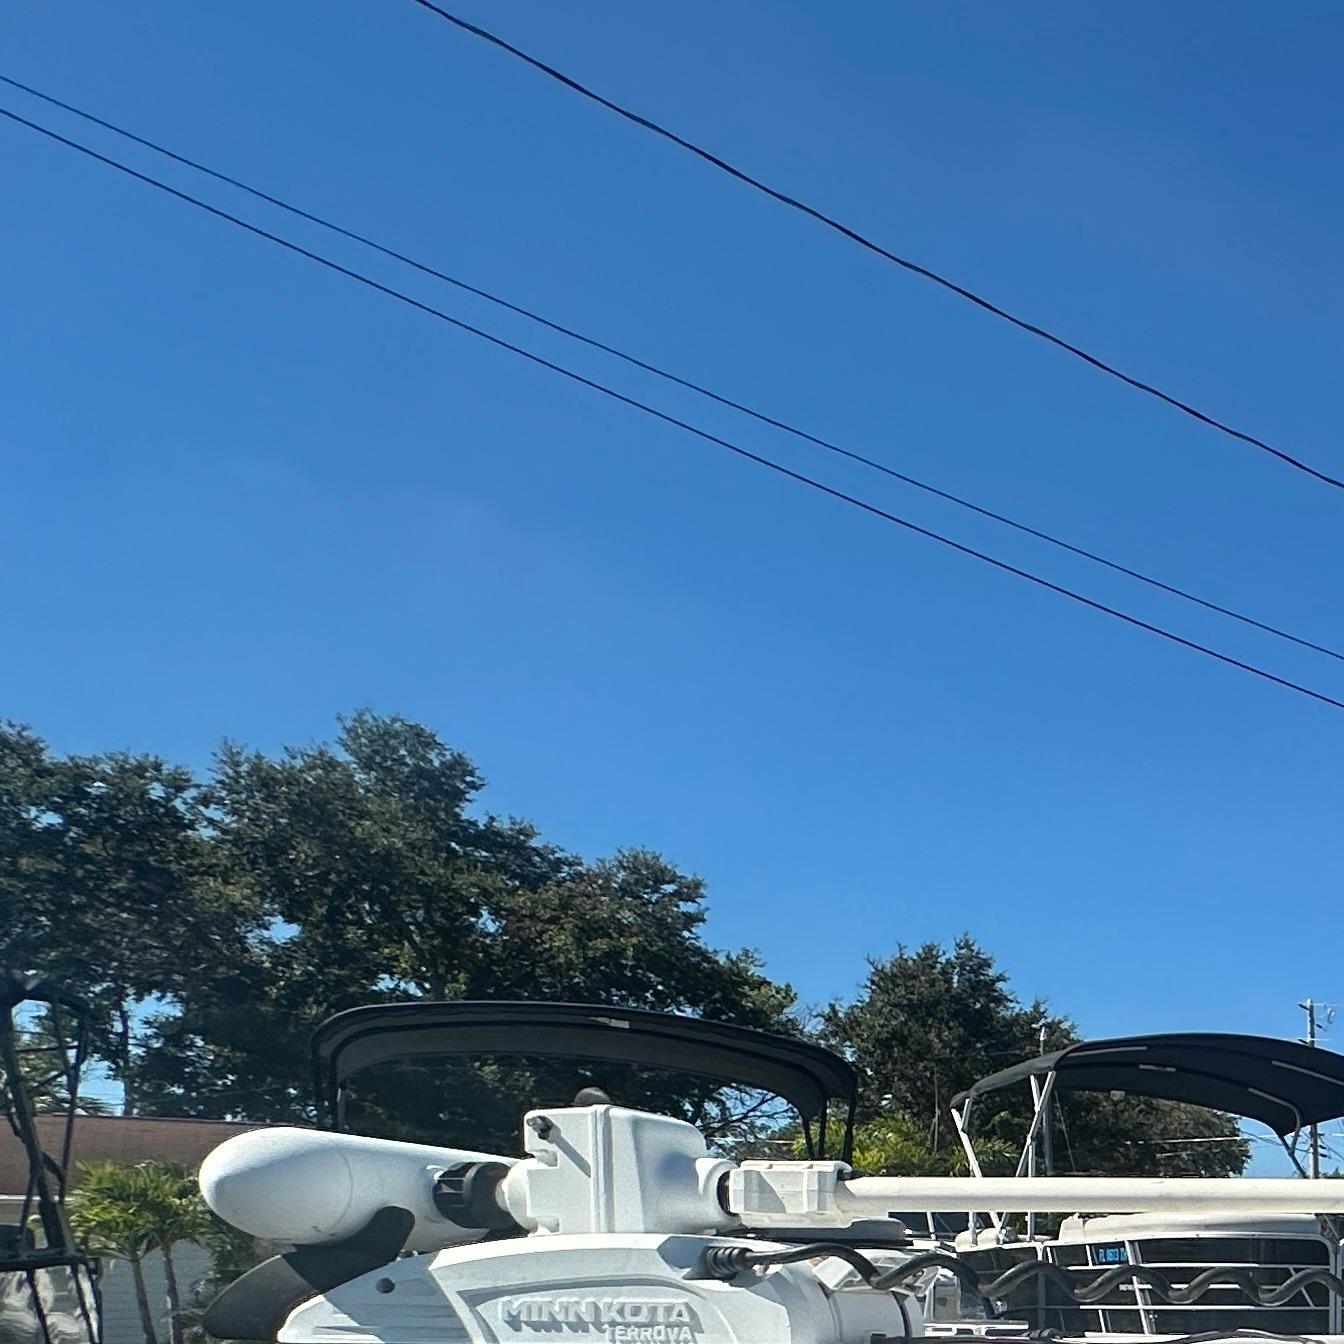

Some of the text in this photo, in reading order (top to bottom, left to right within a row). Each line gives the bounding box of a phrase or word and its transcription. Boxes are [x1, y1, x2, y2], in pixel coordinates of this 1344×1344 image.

[500, 1298, 697, 1327] MINN KOTA
[604, 1324, 694, 1343] TERROVA
